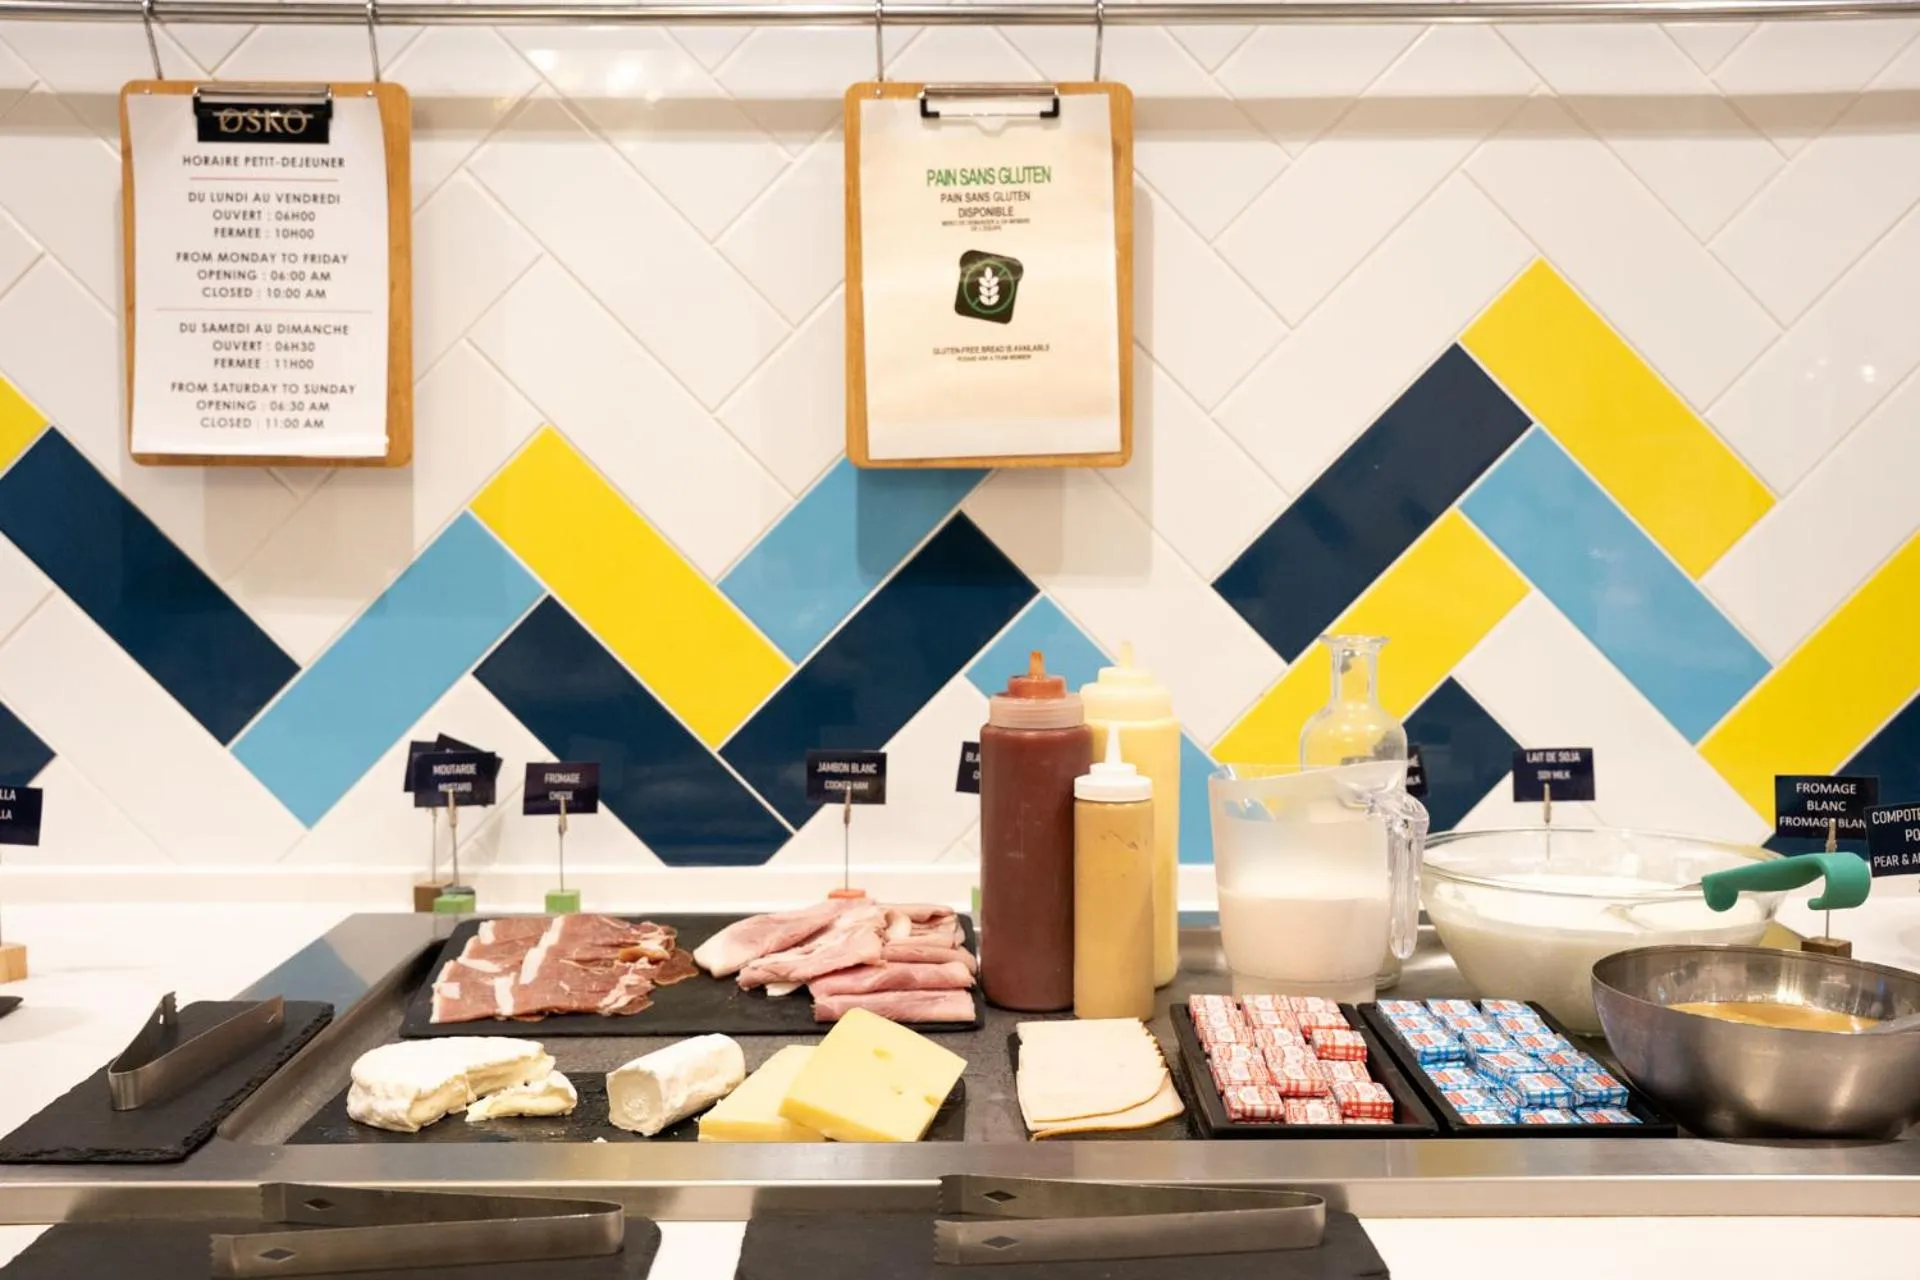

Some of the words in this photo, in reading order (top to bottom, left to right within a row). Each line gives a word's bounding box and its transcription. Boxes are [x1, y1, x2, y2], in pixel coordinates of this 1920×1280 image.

[182, 155, 239, 167] HORAIRE
[243, 156, 345, 168] PETIT-DEJEUNER
[926, 169, 957, 186] PAIN
[959, 167, 996, 186] SANS
[998, 165, 1052, 184] GLUTEN
[188, 192, 205, 203] DU
[210, 192, 248, 203] LUNDI
[252, 192, 271, 203] AU
[275, 193, 341, 205] VENDREDI
[940, 193, 962, 203] PAIN
[964, 192, 990, 203] SANS
[993, 190, 1031, 202] GLUTEN
[212, 209, 262, 221] OUVERT
[275, 211, 316, 221] 06H00
[958, 206, 1014, 218] DISPONIBLE
[213, 227, 260, 239] FERMEE
[275, 228, 315, 239] 10H00
[176, 252, 213, 263] FROM
[217, 252, 277, 264] MONDAY
[281, 253, 298, 264] TO
[302, 253, 348, 264] FRIDAY
[197, 269, 258, 281] OPENING
[270, 270, 306, 281] 06:00
[310, 271, 332, 281] AM
[201, 286, 254, 298] CLOSED
[266, 288, 301, 299] 10:00
[305, 289, 327, 299] AM
[179, 322, 197, 333] DU
[201, 322, 250, 333] SAMEDI
[254, 323, 273, 334] AU
[277, 324, 349, 335] DIMANCHE
[212, 340, 262, 351] OUVERT
[275, 341, 316, 352] 06H30
[213, 358, 260, 369] FERMEE
[275, 359, 315, 369] 11H00
[170, 382, 208, 393] FROM
[212, 382, 277, 394] SATURDAY
[282, 383, 299, 394] TO
[303, 384, 356, 395] SUNDAY
[196, 399, 257, 411] OPENING
[269, 401, 305, 411] 06:30
[309, 402, 330, 411] AM
[200, 416, 252, 428] CLOSED
[265, 418, 299, 428] 11:00
[303, 418, 325, 428] AM
[850, 762, 877, 775] BLANC
[1795, 782, 1857, 795] FROMAGE
[1806, 800, 1847, 812] BLANC
[1873, 854, 1900, 868] PEAR
[1902, 853, 1910, 866] &
